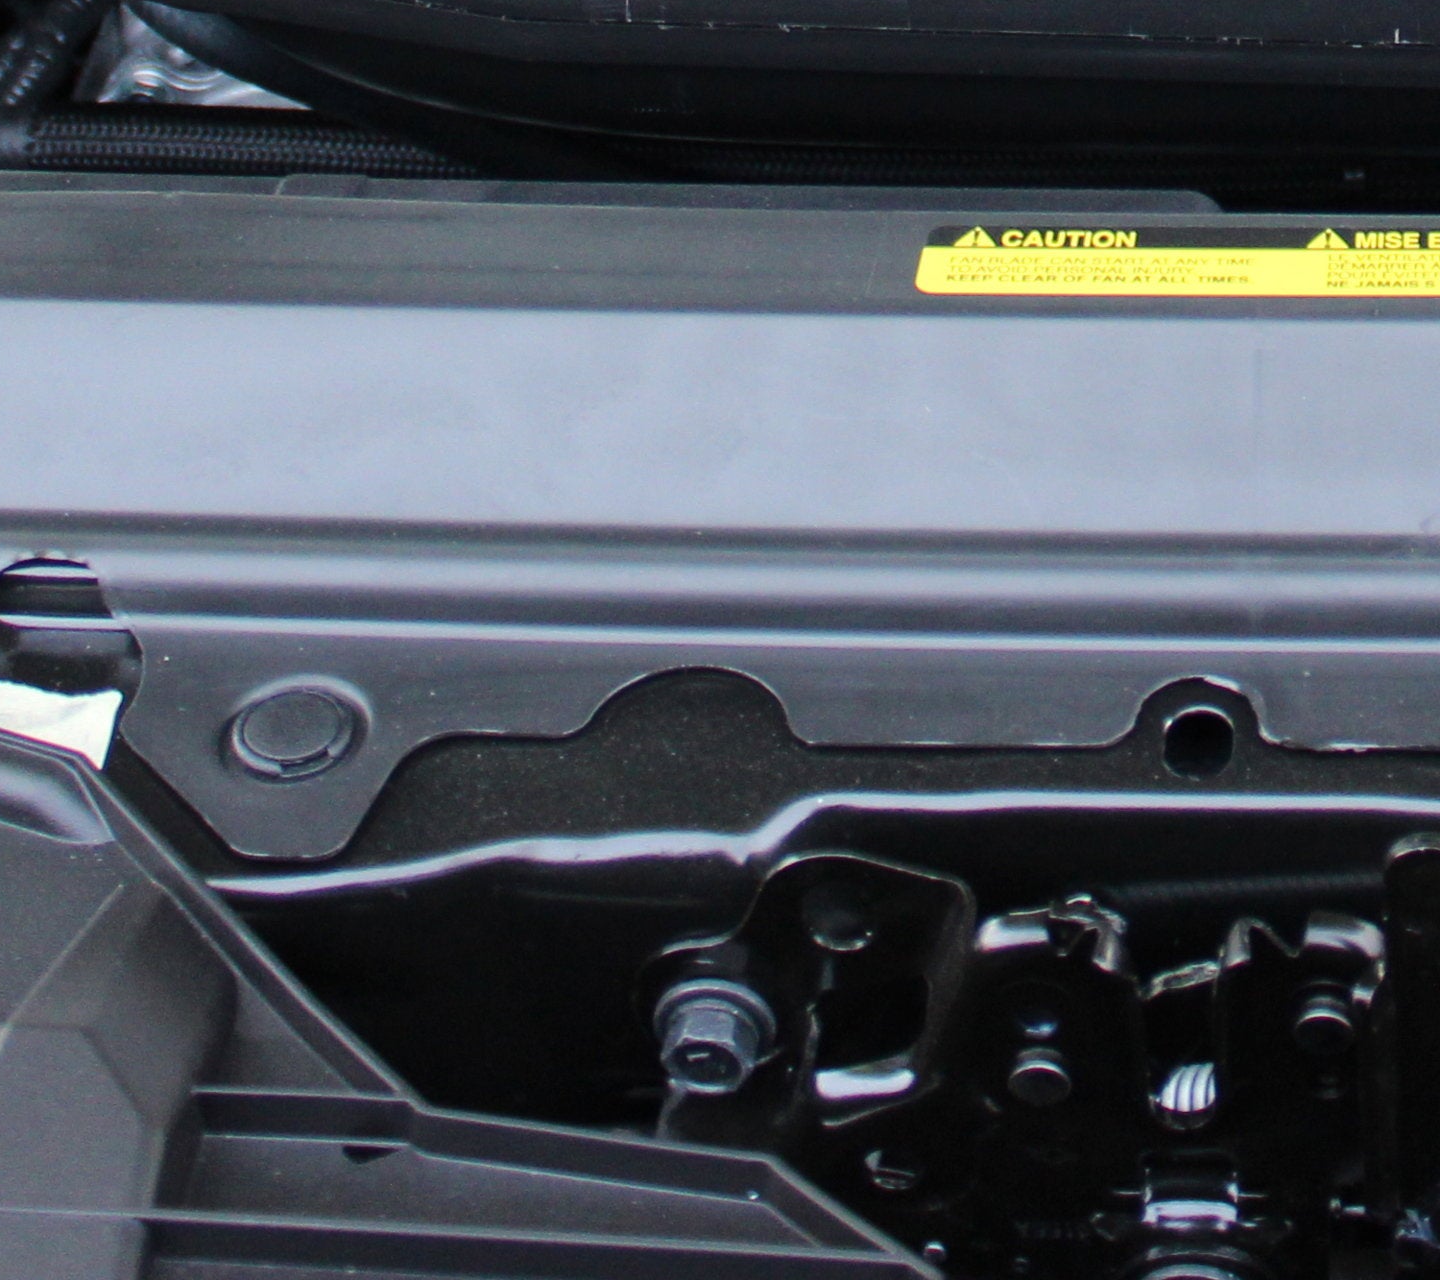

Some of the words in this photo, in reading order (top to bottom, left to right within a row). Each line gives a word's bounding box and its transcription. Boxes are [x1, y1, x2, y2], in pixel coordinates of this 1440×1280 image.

[1001, 230, 1137, 248] CAUTION
[1354, 231, 1420, 249] MISE
[949, 256, 983, 265] FAN
[989, 256, 1045, 265] BLADE
[1051, 256, 1086, 265] CAN
[1092, 256, 1143, 265] START
[1152, 256, 1169, 265] AT
[1176, 256, 1209, 265] ANY
[1328, 253, 1348, 262] LE
[949, 265, 972, 274] TO
[976, 265, 1027, 274] AVOID
[1034, 265, 1124, 274] PERSONAL
[946, 274, 993, 283] KEEP
[998, 274, 1057, 283] CLEAR
[1063, 274, 1084, 283] OF
[1092, 274, 1127, 283] FAN
[1132, 274, 1152, 283] AT
[1158, 274, 1187, 283] ALL
[1327, 270, 1376, 279] POUR
[1326, 280, 1349, 289] NE
[1355, 280, 1419, 289] JAMAIS
